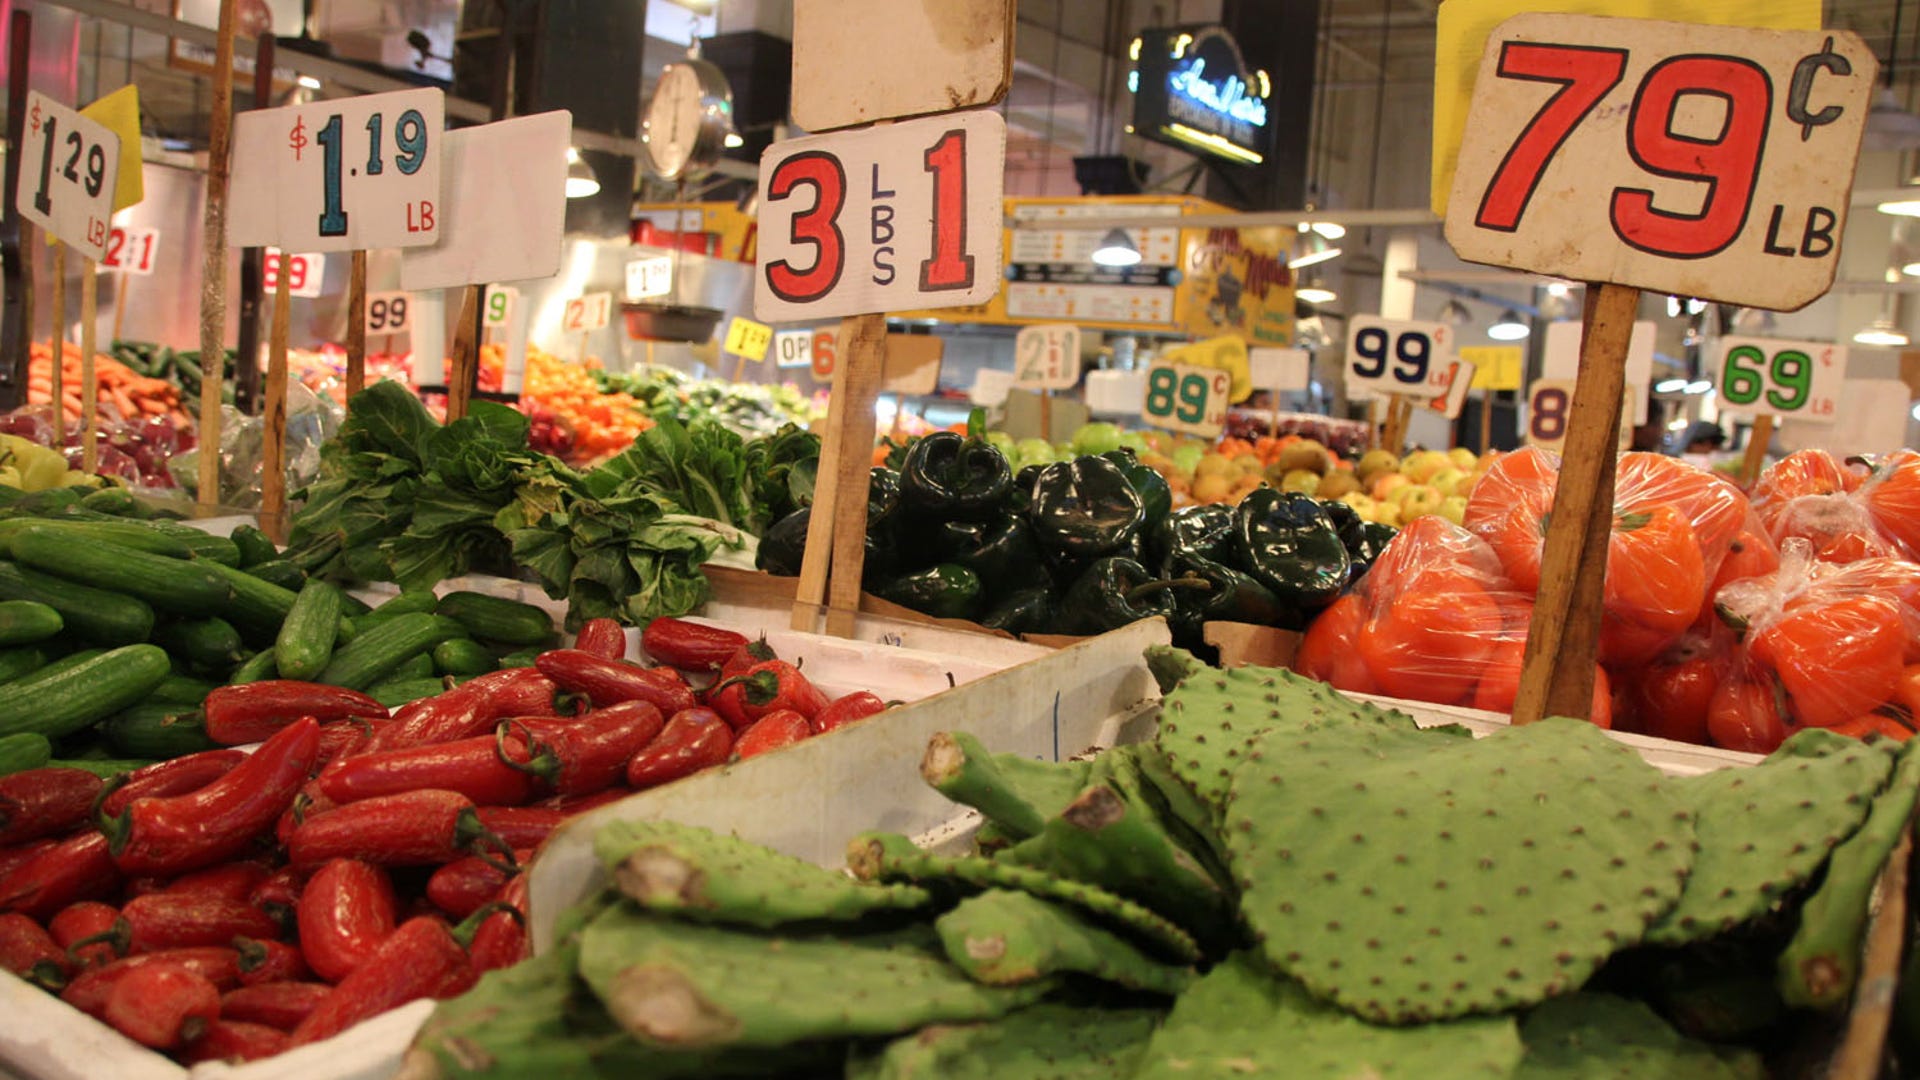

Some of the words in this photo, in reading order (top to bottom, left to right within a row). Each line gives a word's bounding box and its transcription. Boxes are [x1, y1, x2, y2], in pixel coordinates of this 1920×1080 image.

[87, 216, 104, 248] LB
[407, 201, 435, 232] LB
[765, 150, 847, 303] 3
[919, 129, 975, 292] 1
[1763, 205, 1837, 259] LB
[104, 228, 126, 267] 2
[139, 234, 153, 270] 1
[369, 297, 407, 329] 99
[567, 299, 585, 331] 2
[1021, 331, 1045, 381] 2
